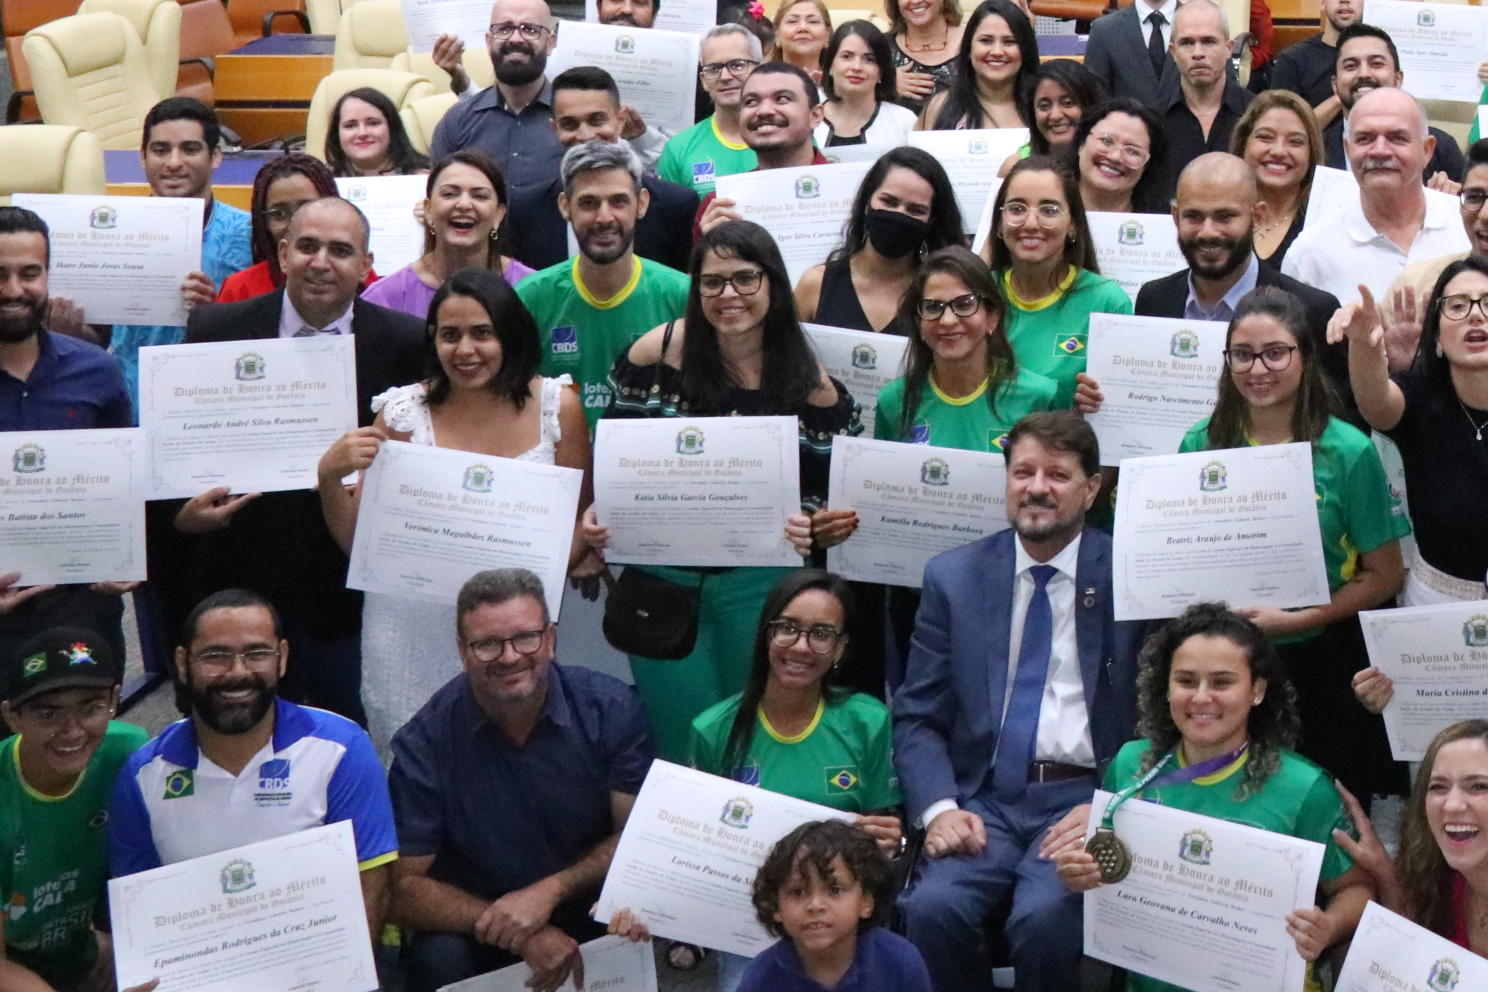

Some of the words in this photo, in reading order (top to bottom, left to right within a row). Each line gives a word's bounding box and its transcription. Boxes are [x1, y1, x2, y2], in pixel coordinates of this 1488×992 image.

[552, 341, 578, 353] CBDS
[173, 386, 219, 397] Diploma
[222, 384, 233, 394] de
[237, 382, 271, 394] Honra
[274, 383, 287, 391] ao
[584, 383, 612, 394] lote
[584, 395, 611, 408] CAI
[1127, 391, 1158, 402] Rodrigo
[1160, 394, 1204, 405] Nascimento
[182, 420, 222, 430] Leonardo
[225, 419, 249, 427] André
[250, 418, 271, 426] Silva
[273, 417, 318, 425] Rasmussen
[617, 457, 661, 469] Diploma
[663, 457, 675, 468] de
[677, 456, 710, 469] Honra
[712, 459, 724, 468] ao
[726, 456, 762, 468] Mérito
[397, 483, 443, 499] Diploma
[445, 491, 458, 502] de
[460, 492, 495, 507] Honra
[497, 500, 510, 509] ao
[1145, 498, 1185, 510] Diploma
[1187, 496, 1198, 506] de
[1201, 494, 1233, 505] Honra
[1235, 494, 1247, 503] ao
[1250, 490, 1287, 503] Mérito
[7, 513, 38, 521] Batista
[39, 512, 54, 520] dos
[56, 511, 85, 519] Santos
[1165, 535, 1193, 544] Beatriz
[1222, 532, 1232, 541] de
[1236, 531, 1267, 540] Amorim
[1399, 652, 1449, 664] Diploma
[1451, 651, 1465, 661] de
[1415, 688, 1442, 697] Maria
[1444, 688, 1479, 696] Cristina
[670, 855, 701, 871] Larissa
[701, 864, 730, 879] Passos
[730, 873, 742, 883] da
[152, 906, 207, 928] Diploma
[209, 902, 222, 913] de
[225, 891, 265, 909] Honra
[268, 887, 282, 898] ao
[285, 876, 326, 896] Mérito
[1116, 889, 1137, 902] Lara
[1177, 906, 1188, 916] de
[1189, 909, 1229, 927] Carvalho
[1231, 920, 1257, 934] Neves
[153, 945, 218, 968] Epaminondas
[220, 933, 267, 950] Rodrigues
[269, 928, 281, 938] da
[282, 923, 305, 934] Cruz
[306, 914, 337, 928] Junior
[1368, 960, 1408, 990] Diploma
